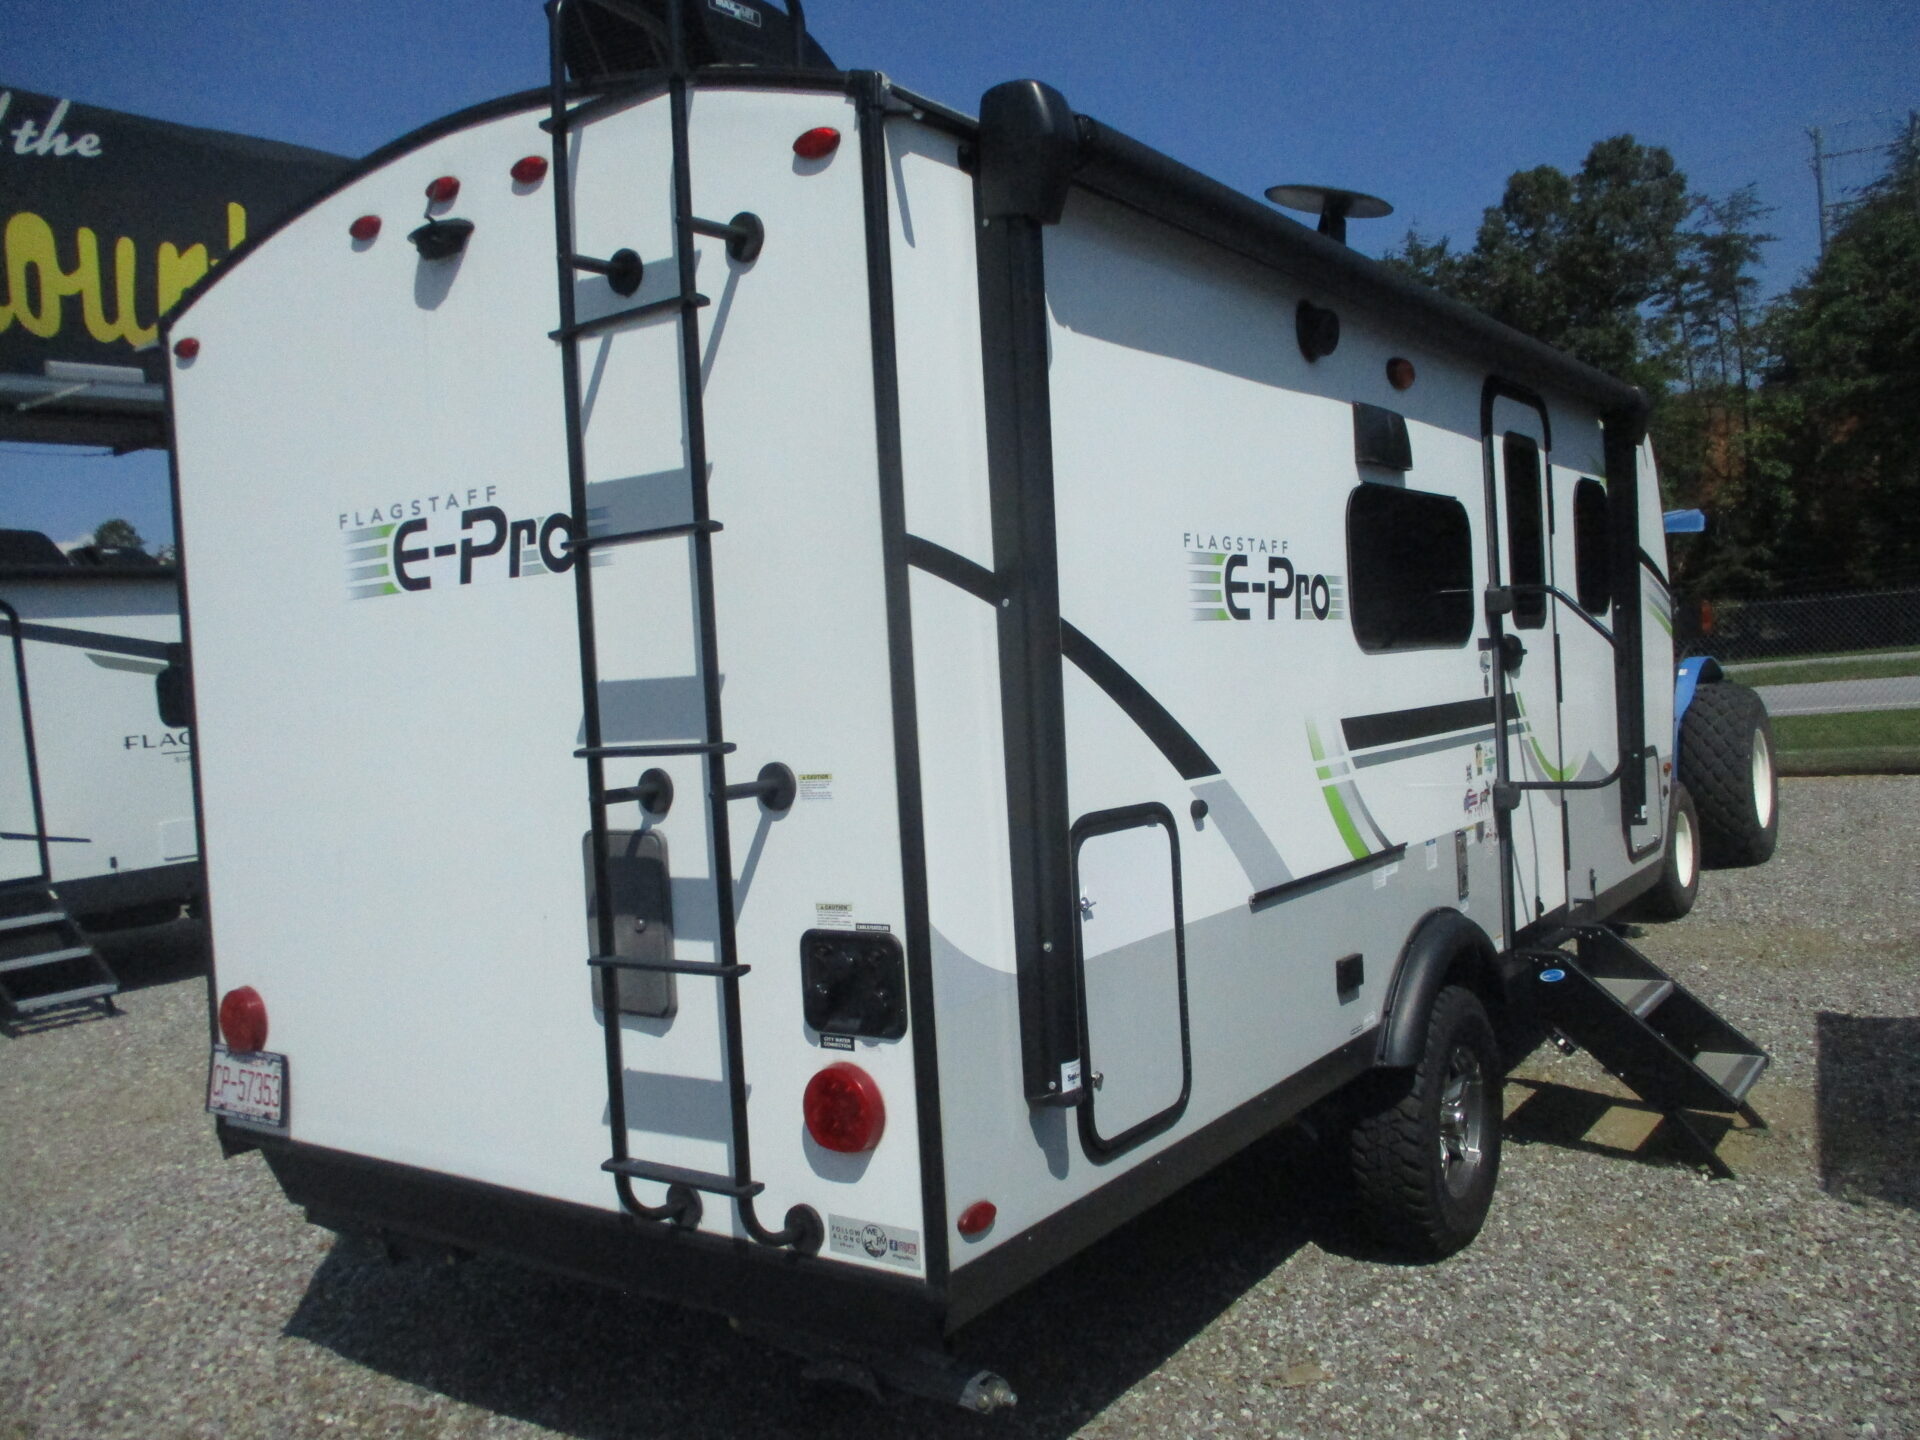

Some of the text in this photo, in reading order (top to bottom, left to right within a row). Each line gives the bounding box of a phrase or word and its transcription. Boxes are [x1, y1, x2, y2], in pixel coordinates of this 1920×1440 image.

[11, 98, 103, 157] the
[339, 485, 497, 530] FLAGSTAFF
[393, 505, 577, 592] E-Pro
[1184, 532, 1289, 554] FLAGSTAFF
[1224, 554, 1331, 621] E-Pro
[831, 1225, 860, 1236] FOLLOW
